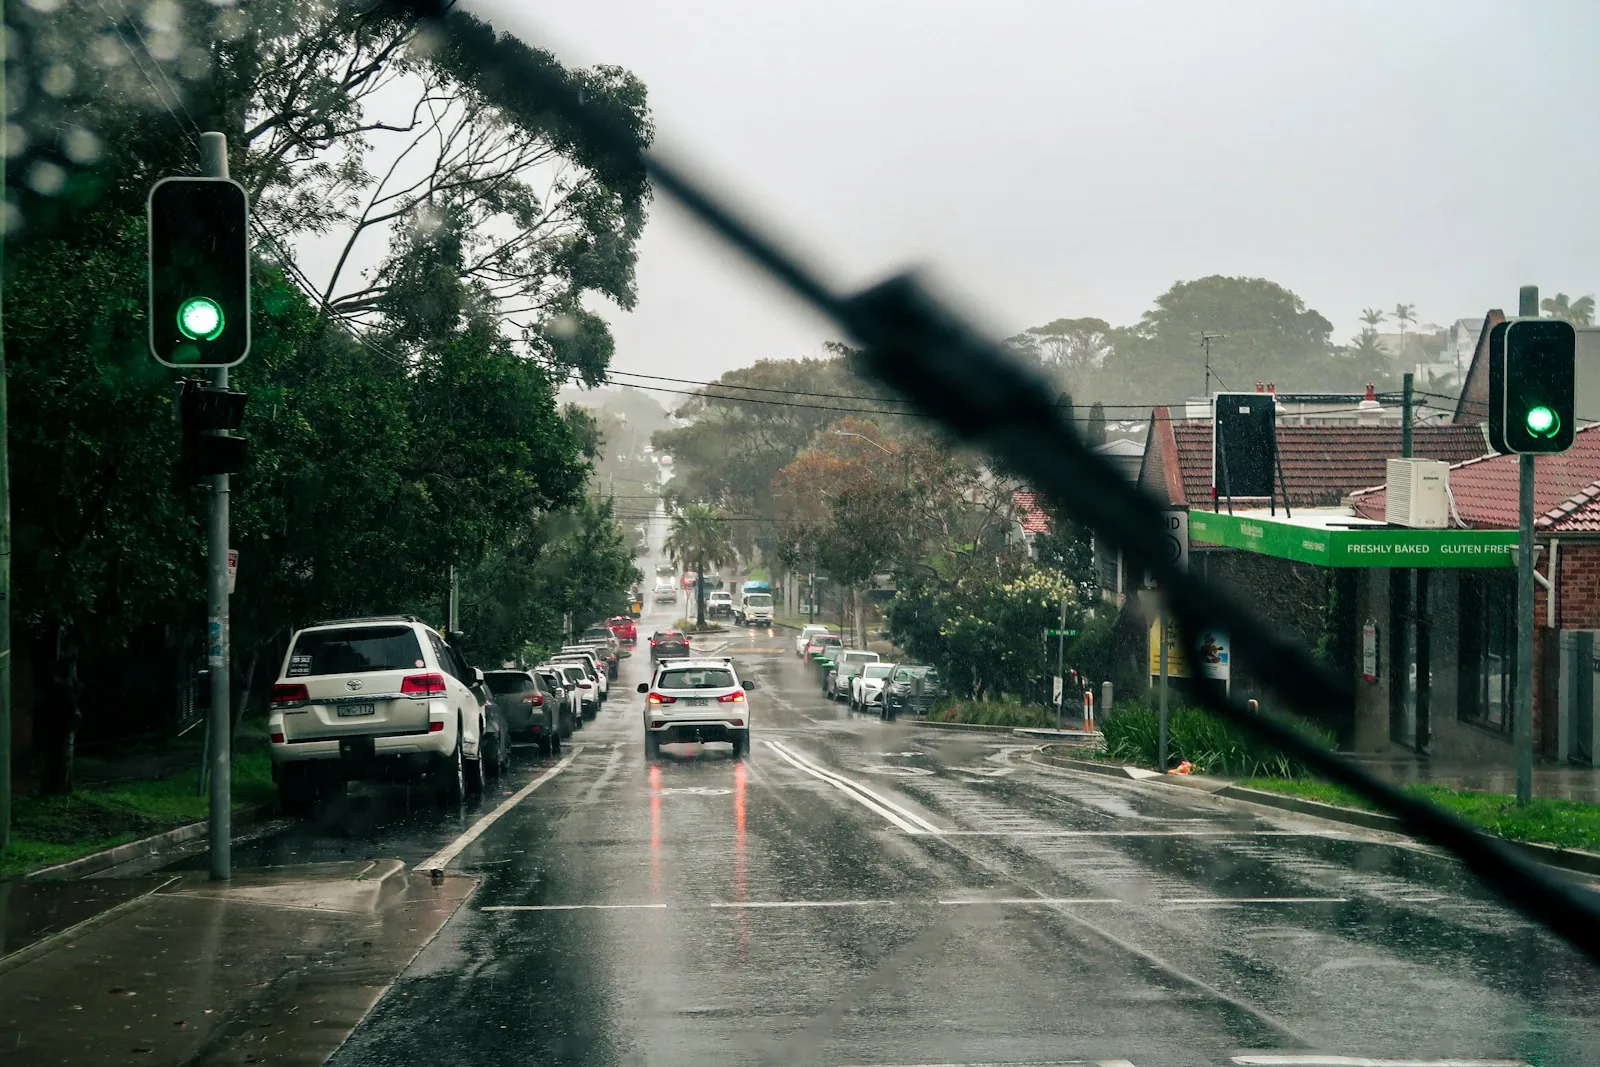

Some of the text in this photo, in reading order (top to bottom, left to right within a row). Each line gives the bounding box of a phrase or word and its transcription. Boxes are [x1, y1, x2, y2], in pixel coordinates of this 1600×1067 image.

[1347, 544, 1430, 553] FRESHLY BAKED
[1440, 544, 1509, 553] GLUTEN FREE
